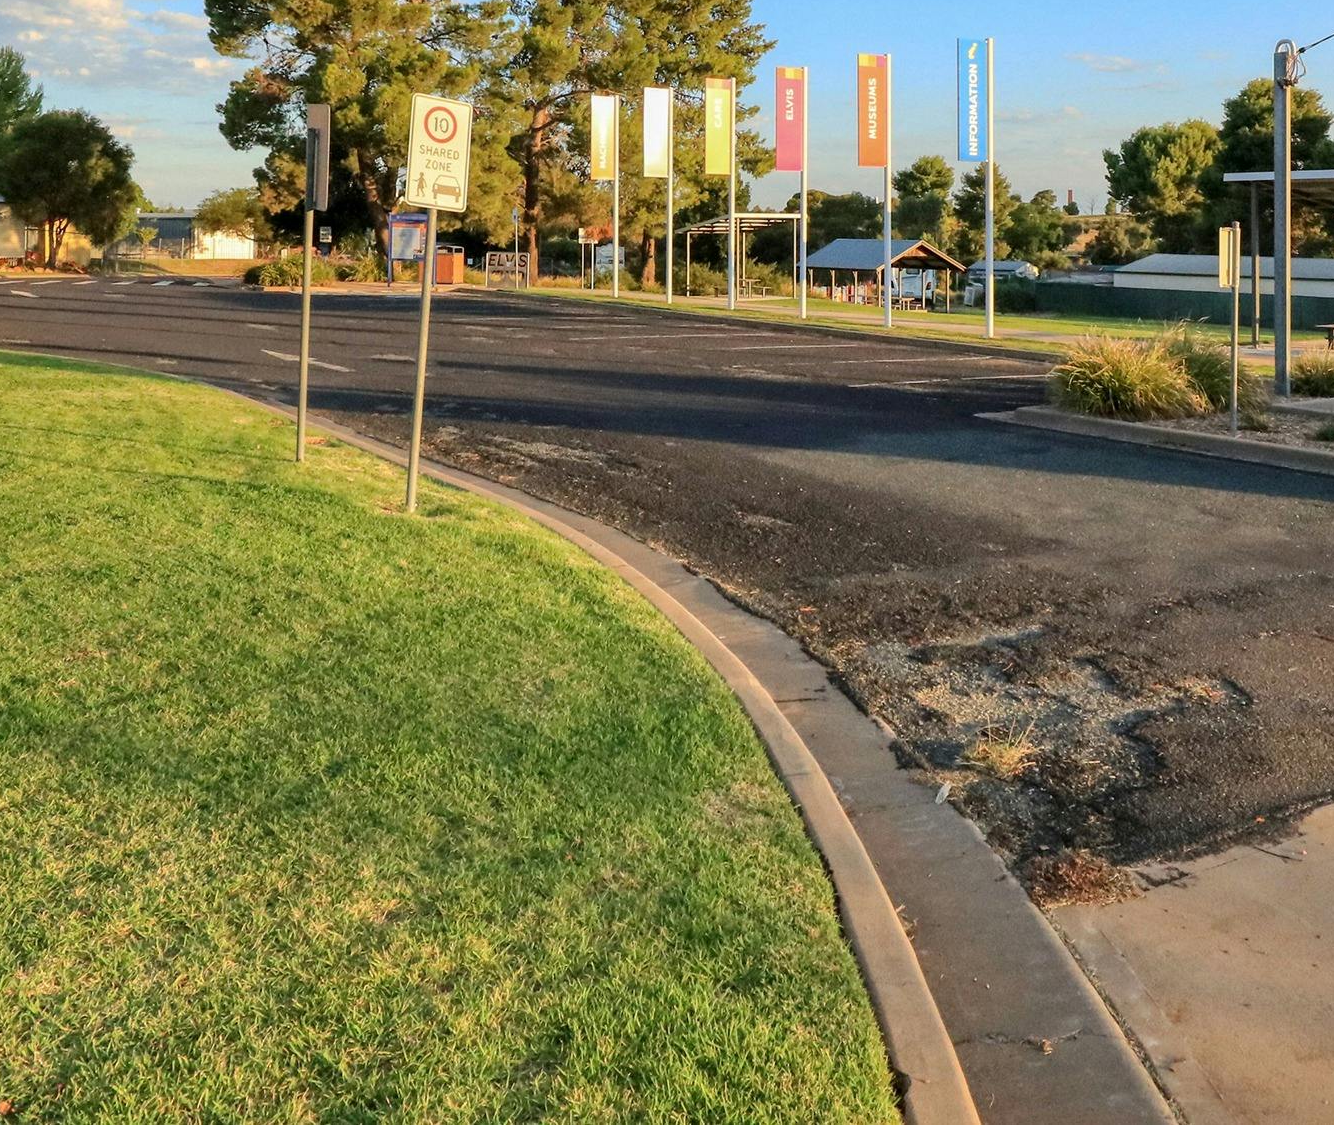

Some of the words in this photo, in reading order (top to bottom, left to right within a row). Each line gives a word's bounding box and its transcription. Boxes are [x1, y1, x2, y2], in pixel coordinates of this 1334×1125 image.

[786, 88, 794, 121] ELVIS
[868, 77, 877, 139] MUSEUMS
[969, 63, 978, 156] INFORMATION
[434, 116, 449, 133] 10
[419, 144, 460, 160] SHARED
[425, 159, 452, 172] ZONE
[488, 253, 527, 268] ELVS
